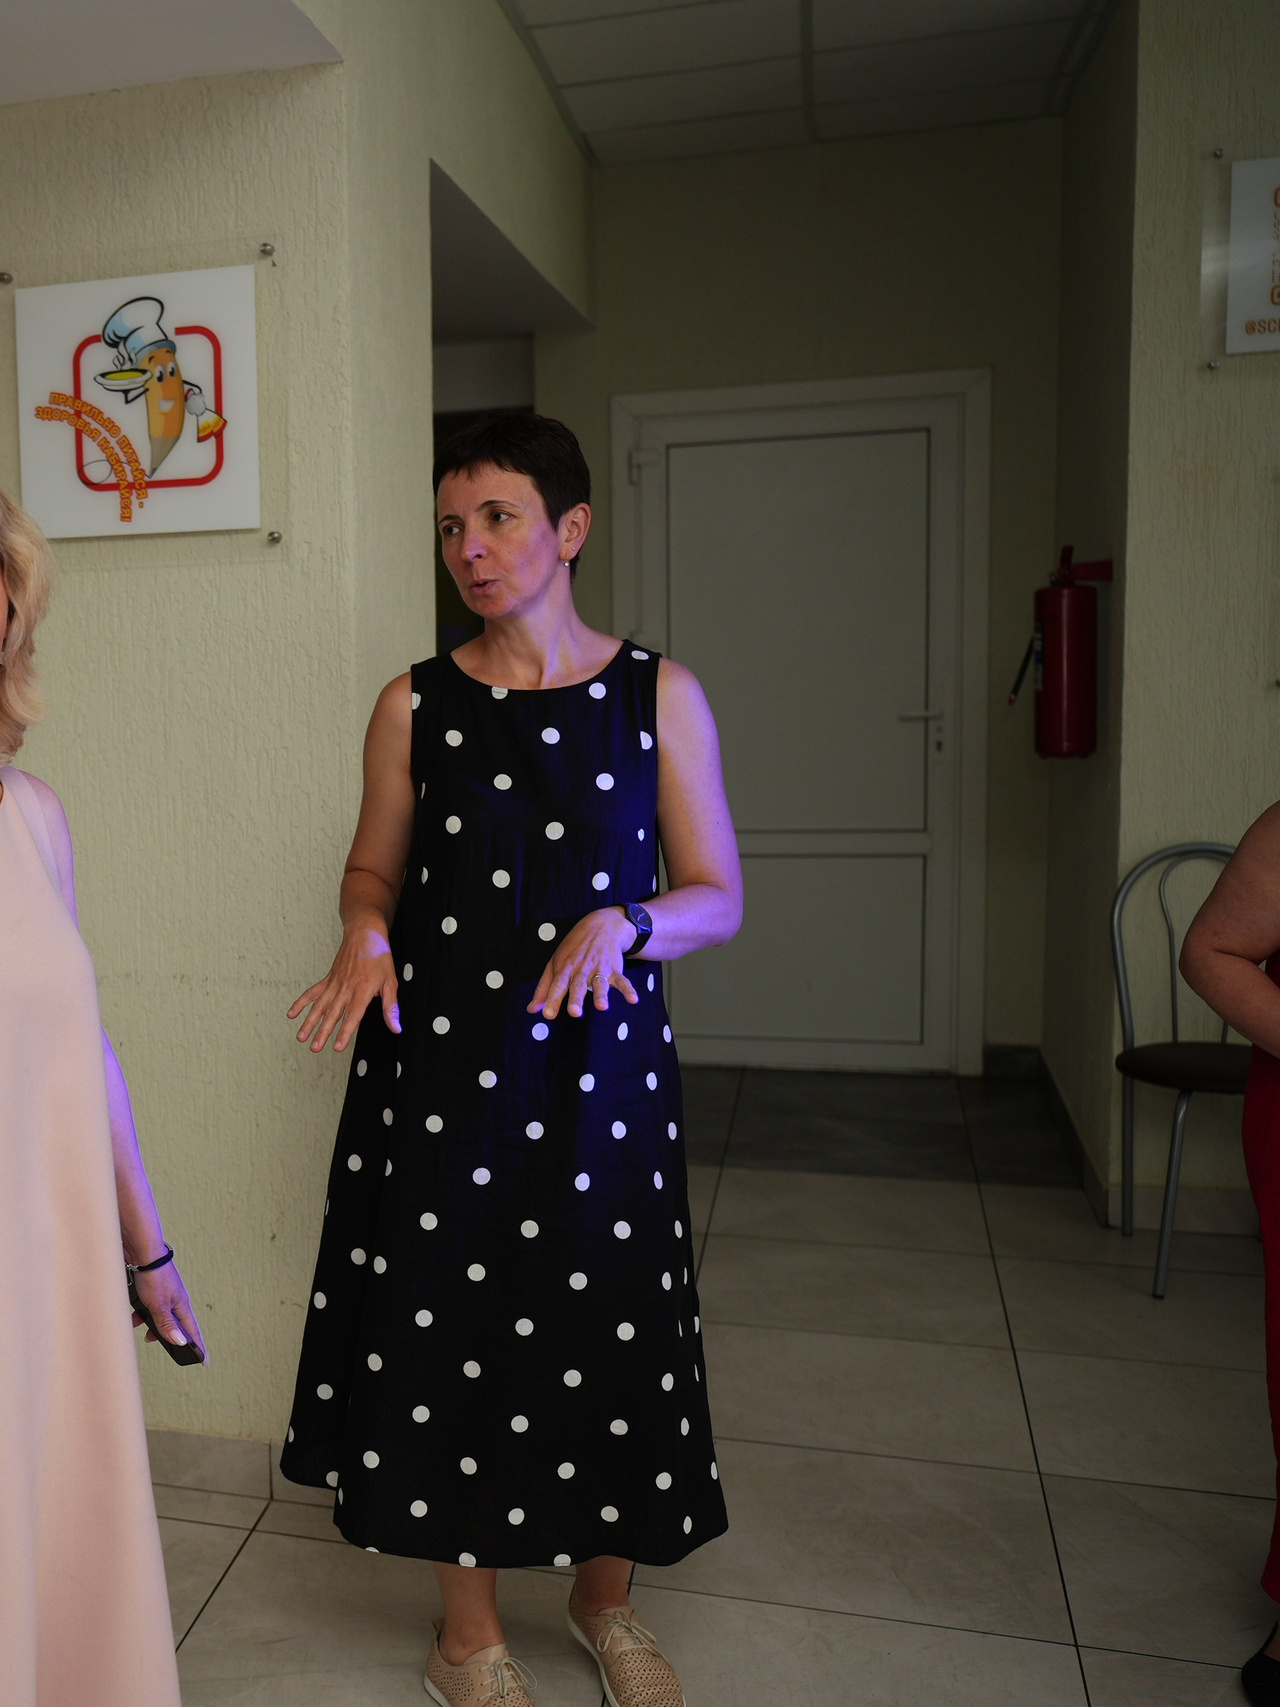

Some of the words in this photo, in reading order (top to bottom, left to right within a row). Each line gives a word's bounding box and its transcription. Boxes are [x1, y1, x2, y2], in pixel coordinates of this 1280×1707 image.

[34, 406, 101, 442] ЗДОРОВЬЯ
[96, 437, 133, 522] НАБИРАЙСЯ!
[48, 392, 122, 438] ПРАВИЛЬНО
[116, 435, 148, 499] ПИТАЙСЯ
